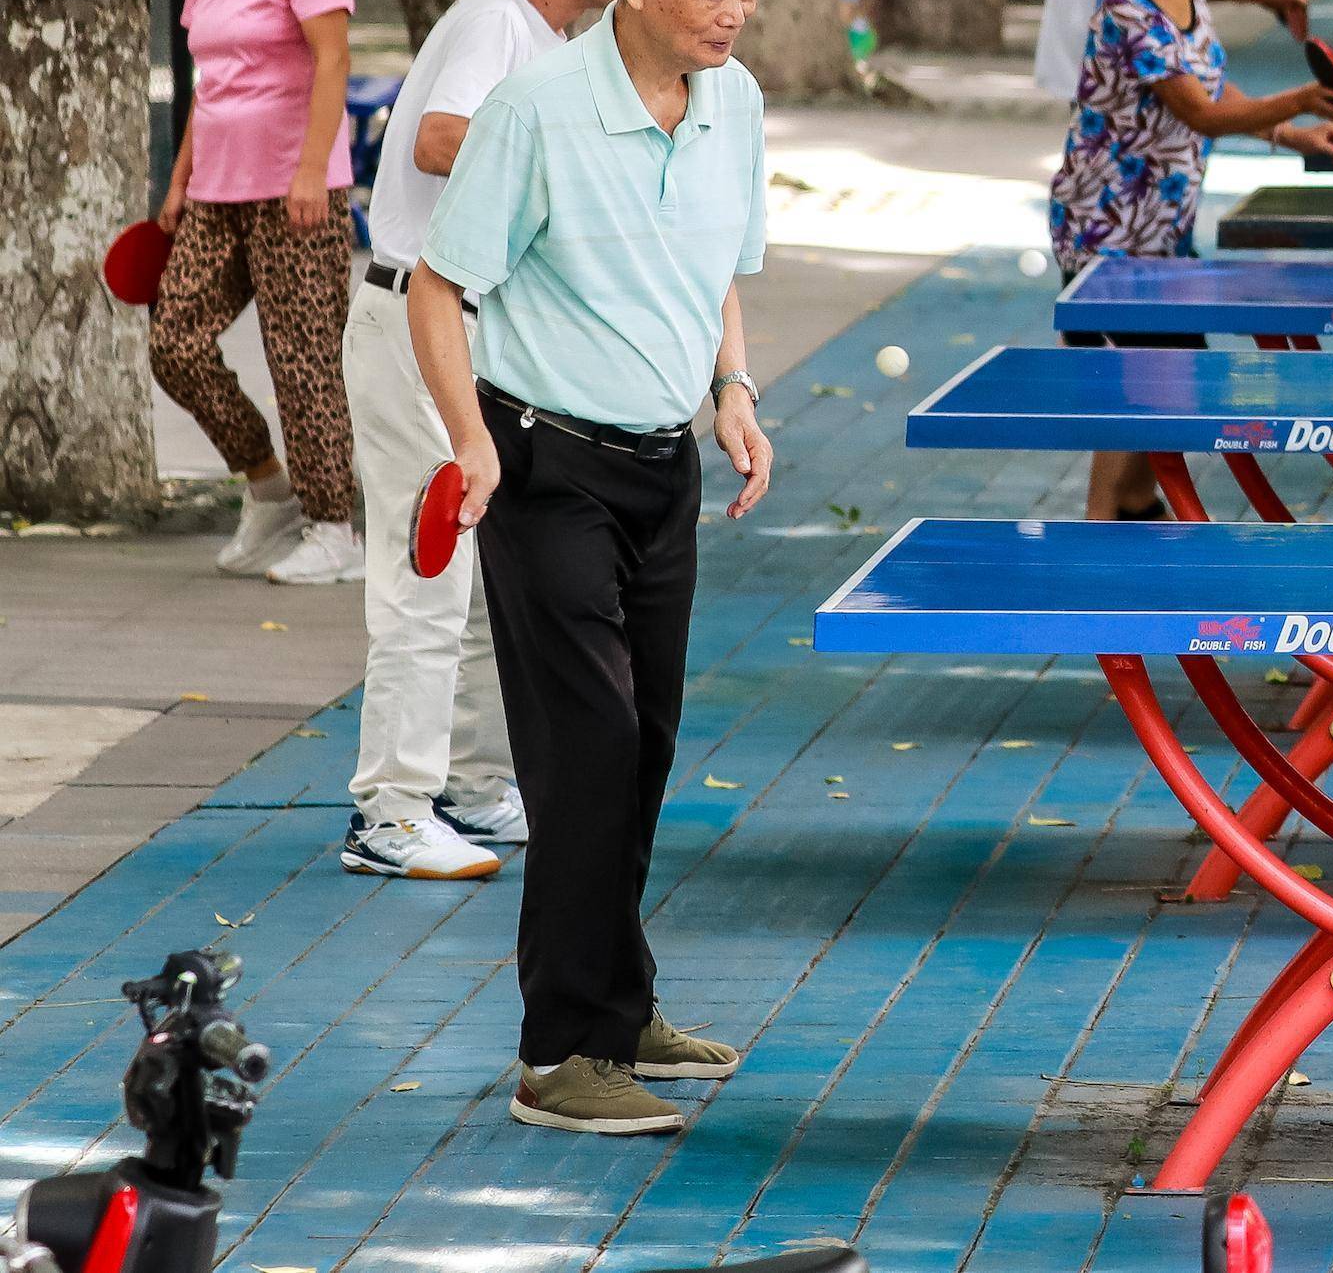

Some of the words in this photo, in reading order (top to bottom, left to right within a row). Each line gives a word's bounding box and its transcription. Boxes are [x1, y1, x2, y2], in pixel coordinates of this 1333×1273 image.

[1214, 438, 1249, 450] DOUBLE
[1259, 441, 1278, 450] FISH
[1189, 638, 1232, 651] DOUBLE
[1244, 640, 1266, 651] FISH
